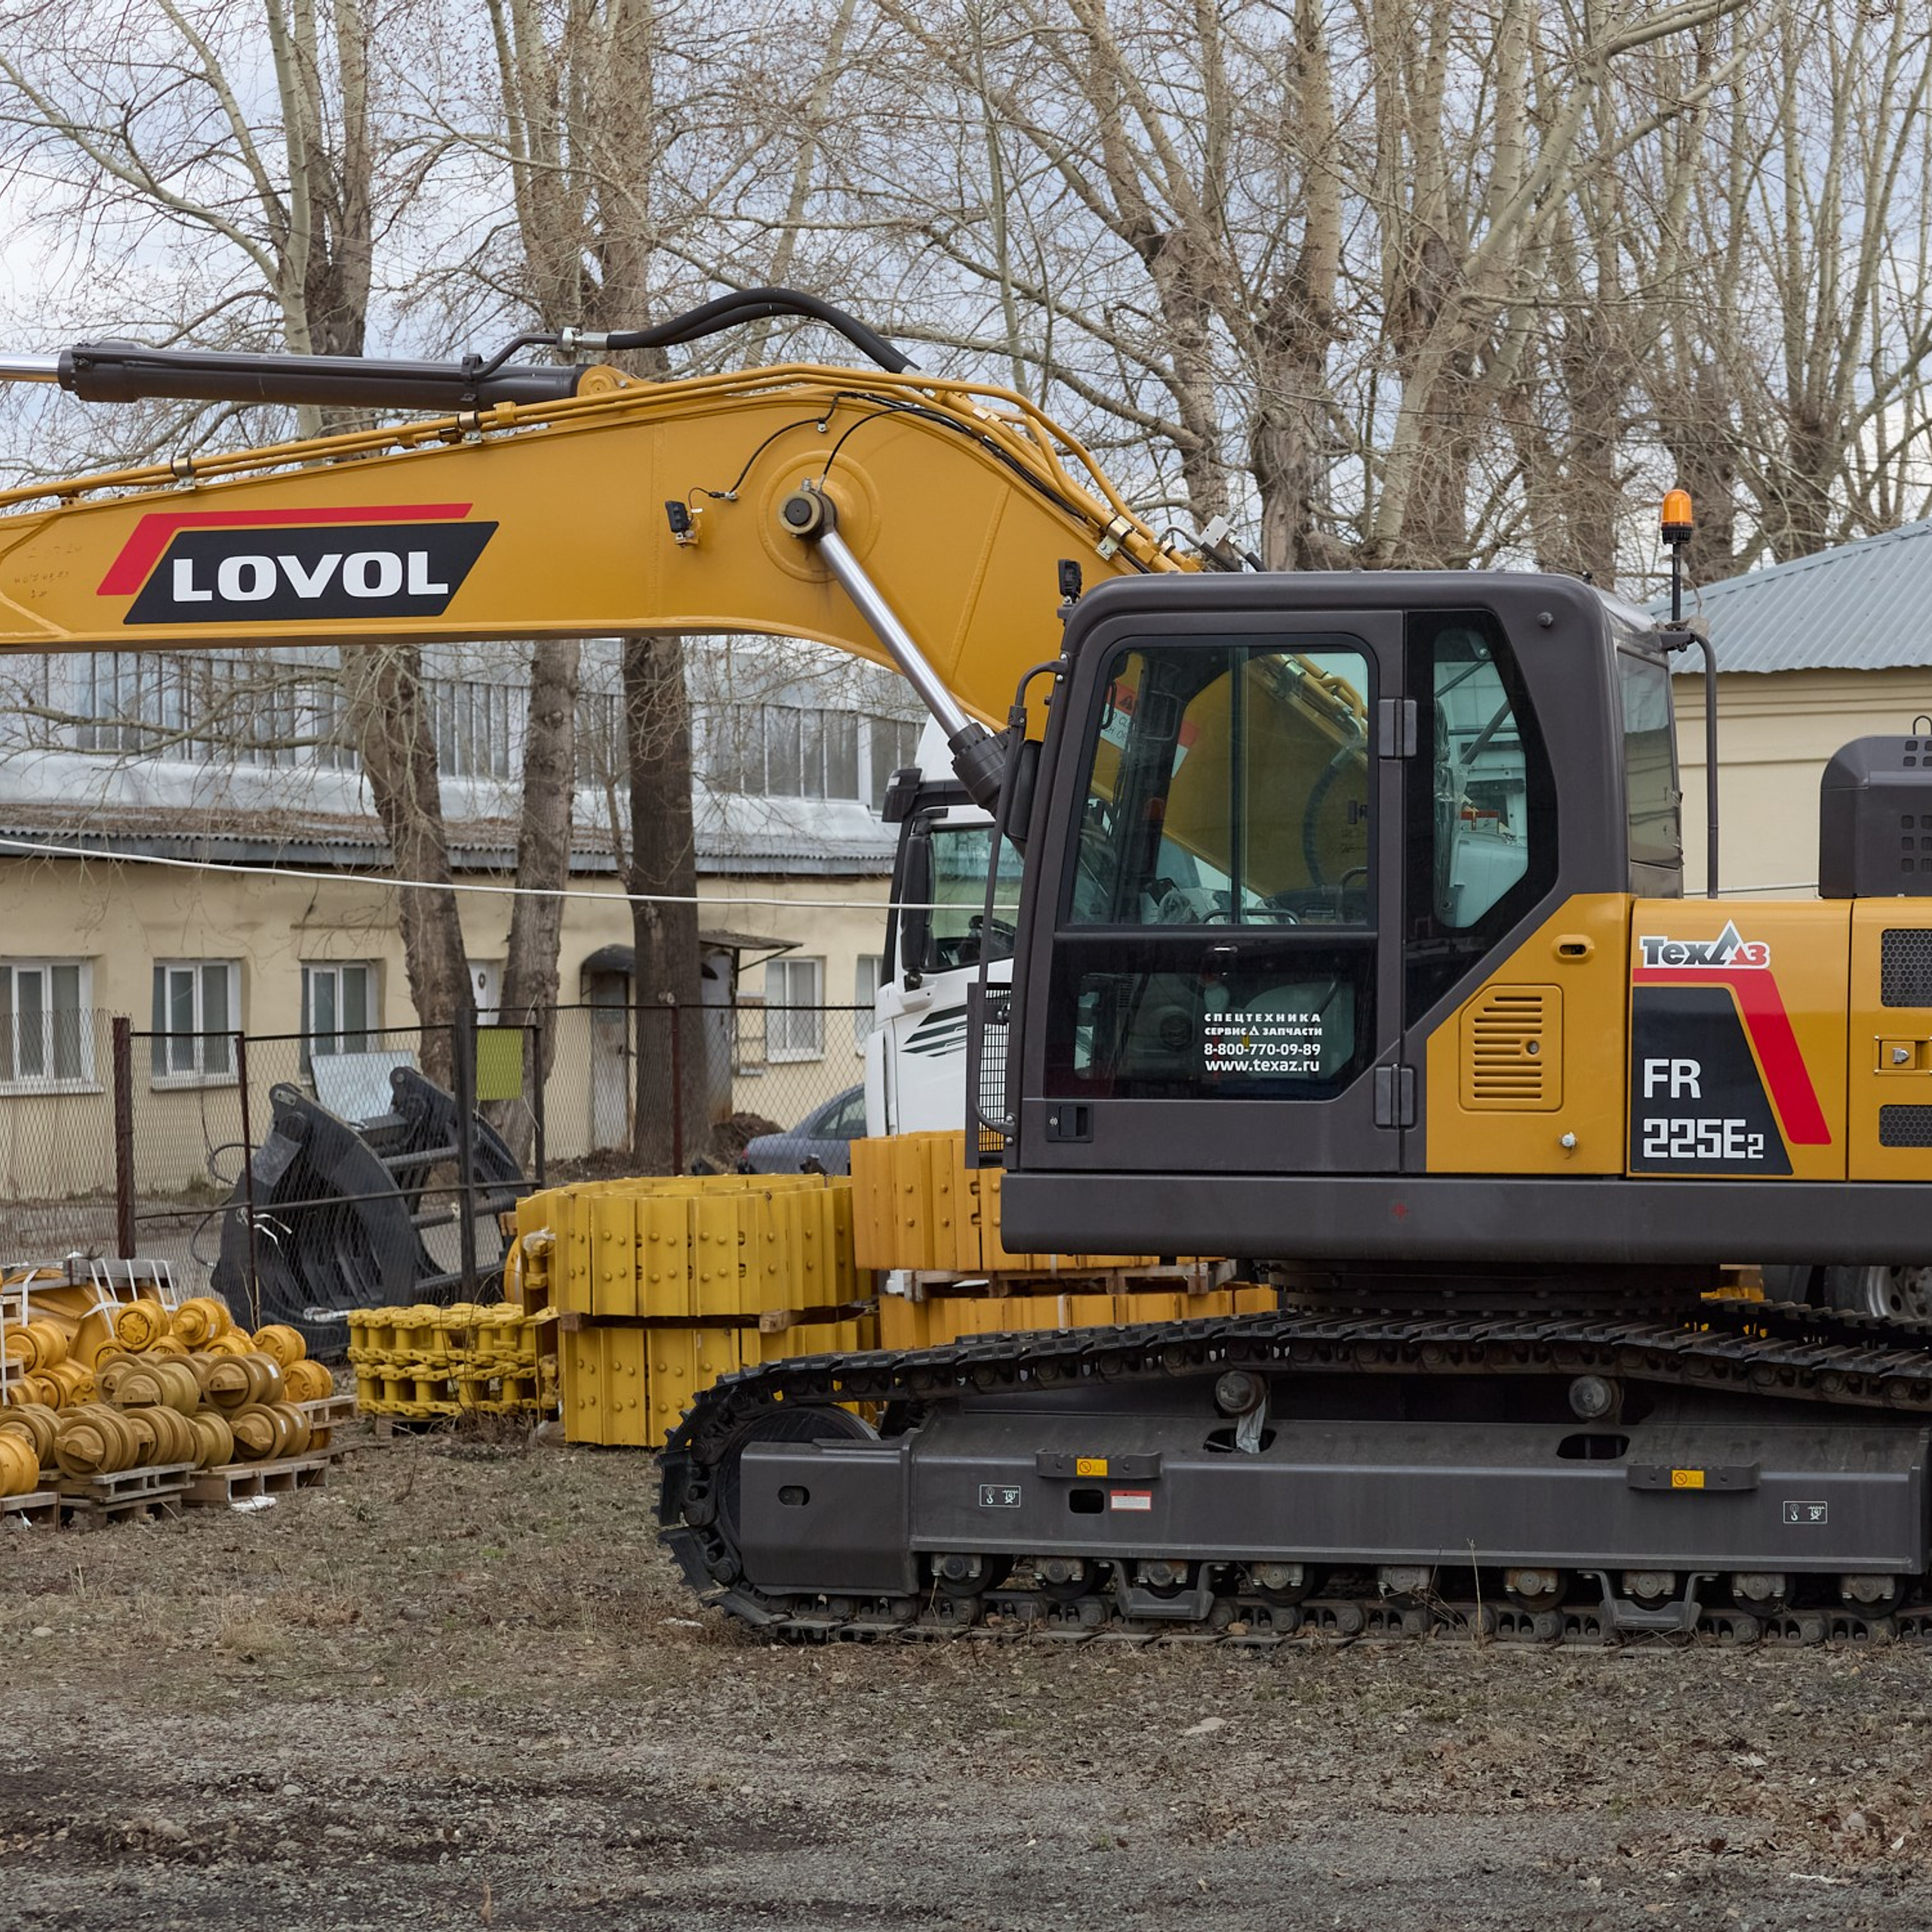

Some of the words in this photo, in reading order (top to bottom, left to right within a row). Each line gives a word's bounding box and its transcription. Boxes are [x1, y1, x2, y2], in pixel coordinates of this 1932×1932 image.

[172, 551, 450, 602] LOVOL
[1204, 1013, 1321, 1023] СПЕЦТЕХНИКА
[1204, 1027, 1247, 1036] СЕРВИС
[1262, 1027, 1322, 1036] ЗАПЧАСТИ
[1204, 1043, 1321, 1056] 8-800-770-09-89
[1204, 1058, 1320, 1072] www.texaz.ru
[1644, 1059, 1702, 1099] FR
[1643, 1118, 1764, 1158] 225E2
